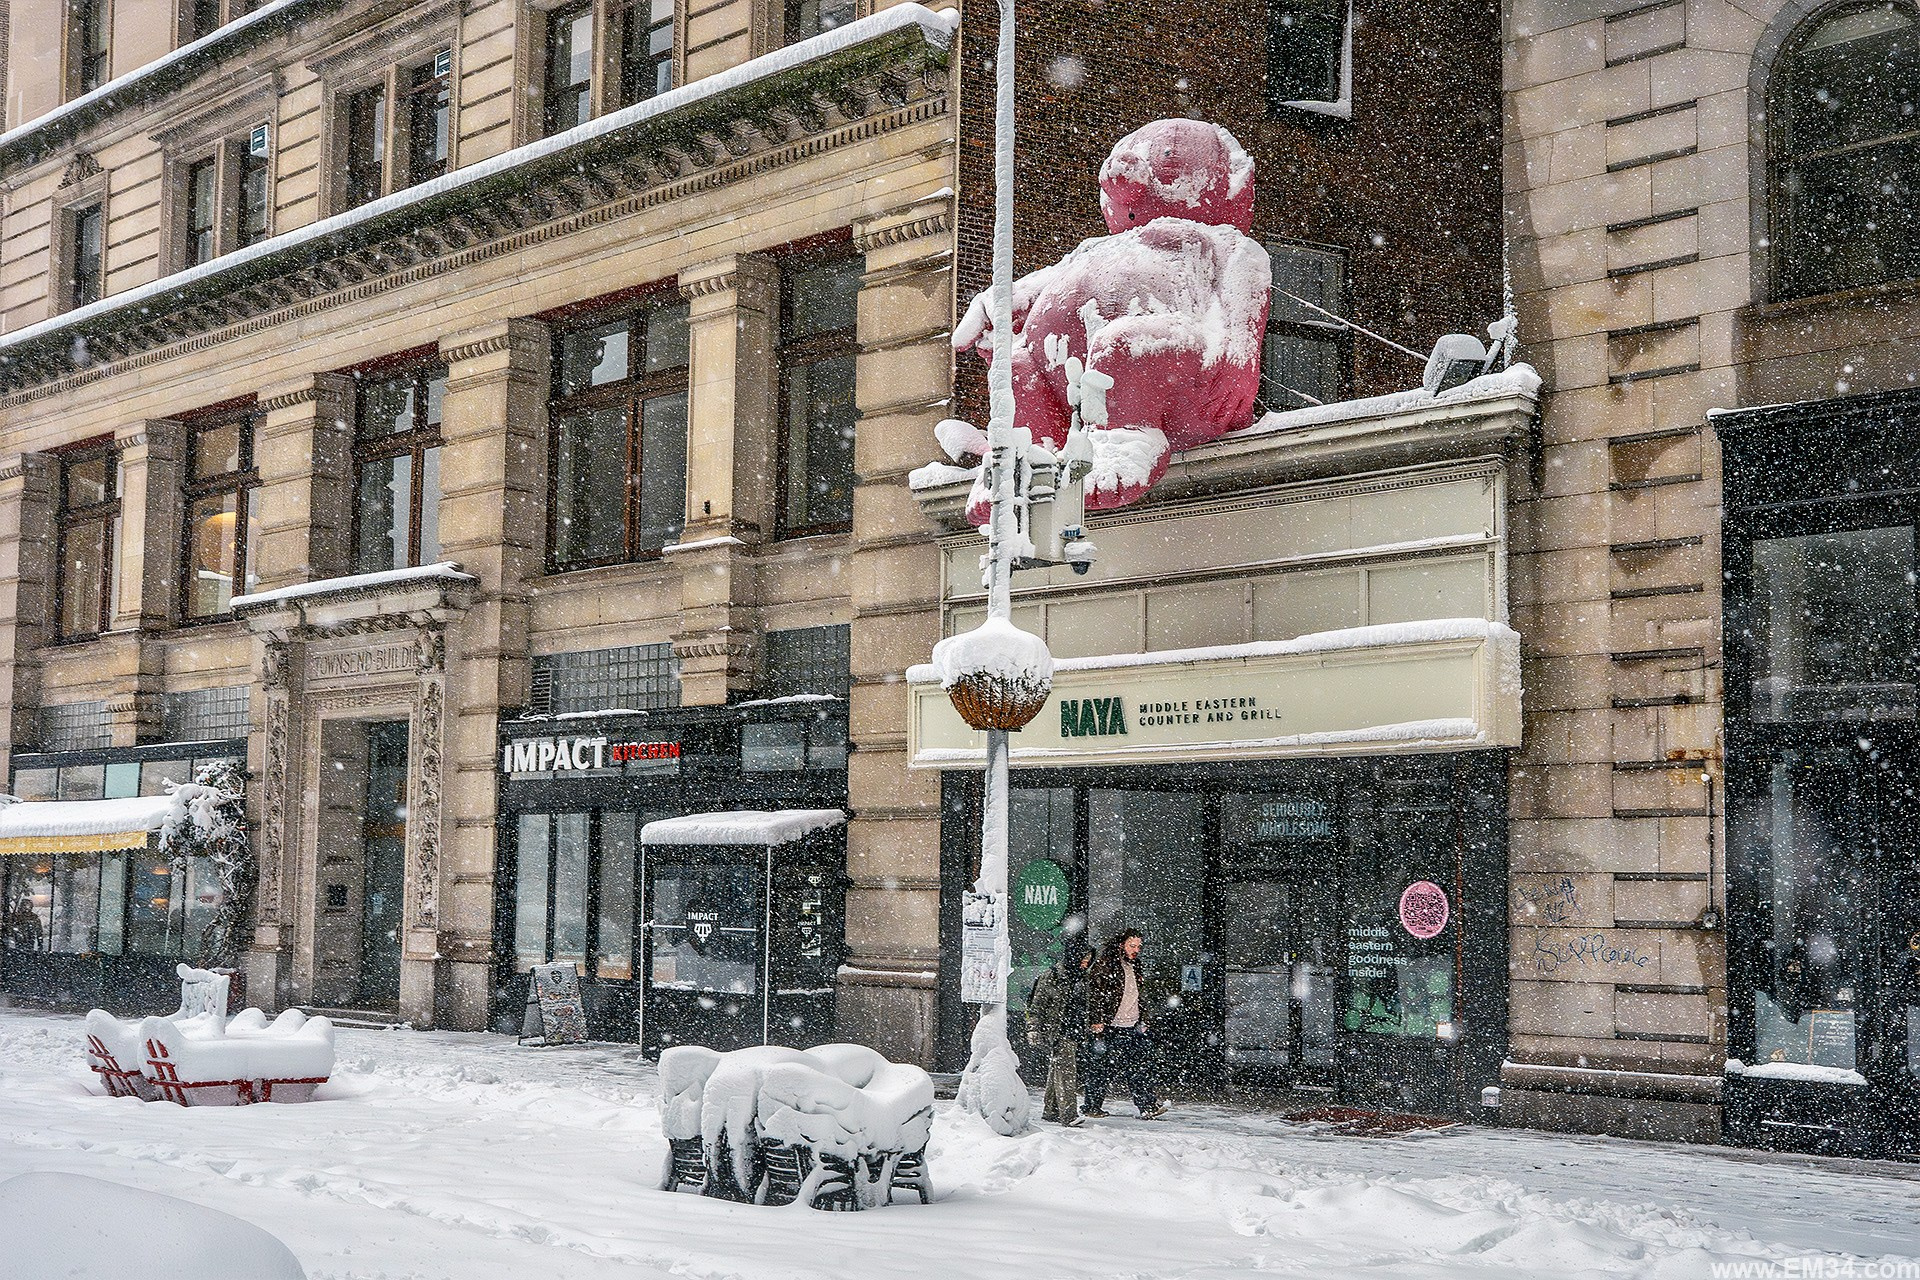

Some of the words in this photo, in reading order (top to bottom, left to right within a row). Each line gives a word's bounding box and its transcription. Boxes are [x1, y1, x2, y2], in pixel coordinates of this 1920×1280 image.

[315, 650, 372, 676] TOWNSEND
[1139, 701, 1188, 713] MIDDLE
[1196, 697, 1256, 711] EASTERN
[1060, 696, 1128, 737] NAYA
[1139, 713, 1200, 726] COUNTER
[1207, 711, 1234, 723] AND
[1240, 708, 1283, 720] GRILL
[503, 737, 607, 773] IMPACT
[612, 741, 681, 761] KITCHEN
[1262, 801, 1326, 818] SERIOUSLY
[1258, 820, 1332, 836] WHOLESOME
[1024, 884, 1058, 905] NAYA
[687, 911, 719, 921] IMPACT
[1348, 926, 1390, 937] middle
[1348, 940, 1393, 951] eastern
[1348, 954, 1408, 966] goodness
[1185, 968, 1199, 984] A
[1348, 967, 1387, 978] inside!
